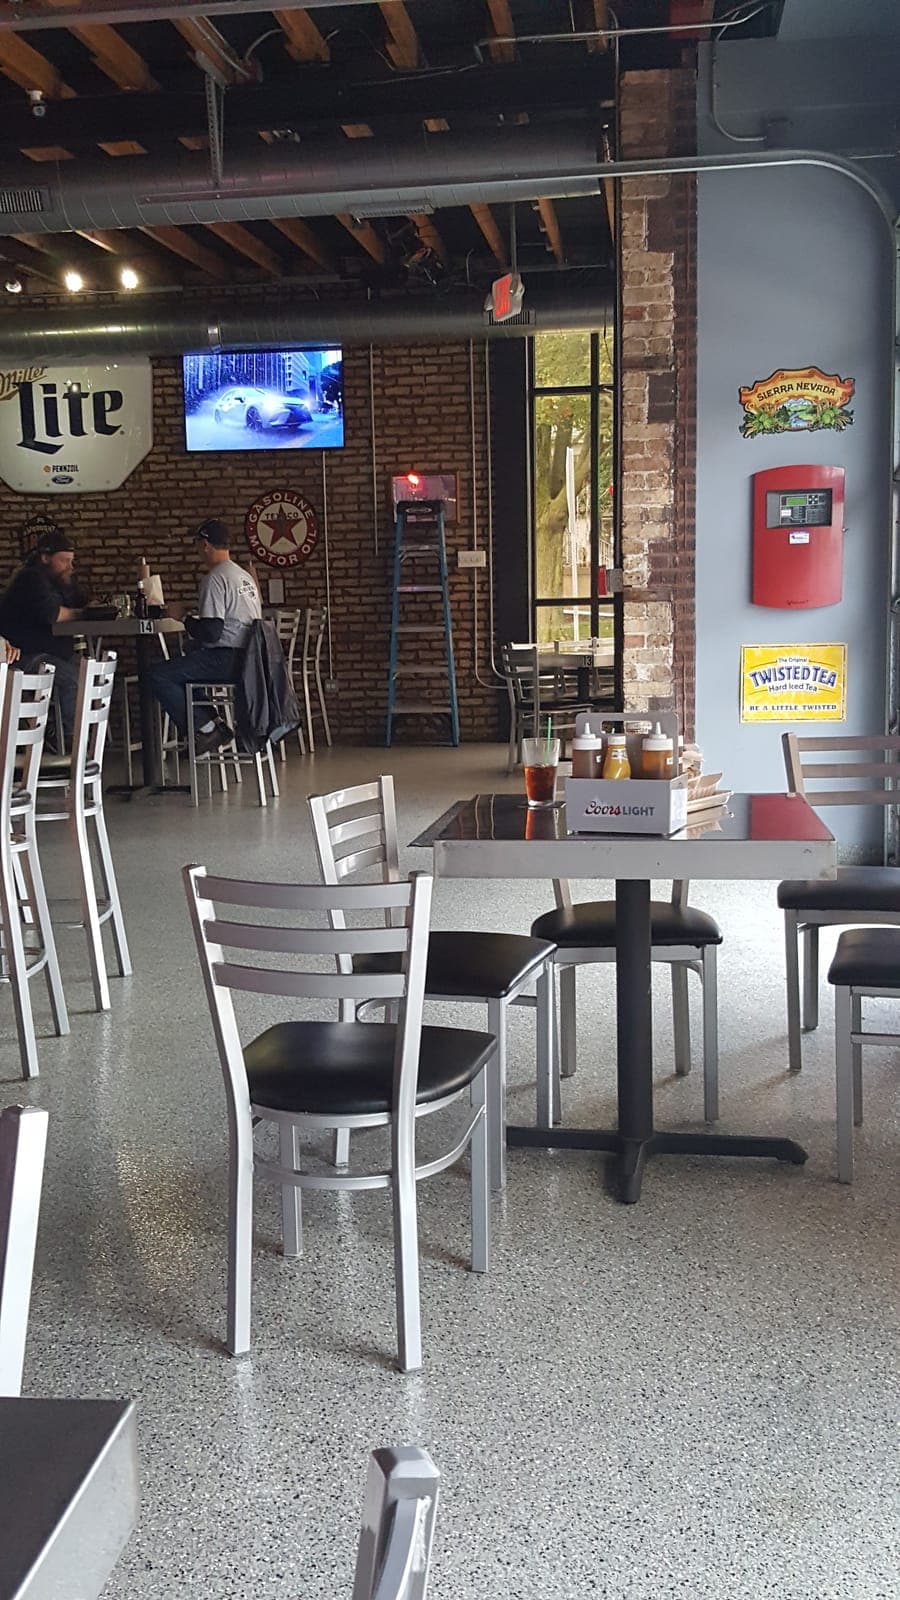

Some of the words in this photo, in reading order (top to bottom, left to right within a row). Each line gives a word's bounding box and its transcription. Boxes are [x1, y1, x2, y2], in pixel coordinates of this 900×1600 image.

[0, 366, 48, 396] Miller
[756, 383, 794, 402] SIERRA
[795, 382, 836, 396] NEVADA
[11, 381, 123, 455] Lite
[52, 464, 79, 472] PENNZOIL
[249, 492, 314, 523] GASOLINE
[264, 512, 299, 520] TECO
[249, 535, 299, 565] MOTOR
[301, 530, 317, 554] OIL
[140, 620, 153, 633] 14
[583, 655, 592, 666] 13
[749, 666, 811, 687] TWISTED
[812, 665, 837, 687] TEA
[769, 683, 787, 692] Hard
[788, 682, 804, 690] Iced
[806, 683, 818, 692] Tea
[585, 801, 621, 816] Coors
[622, 806, 656, 816] LIGHT
